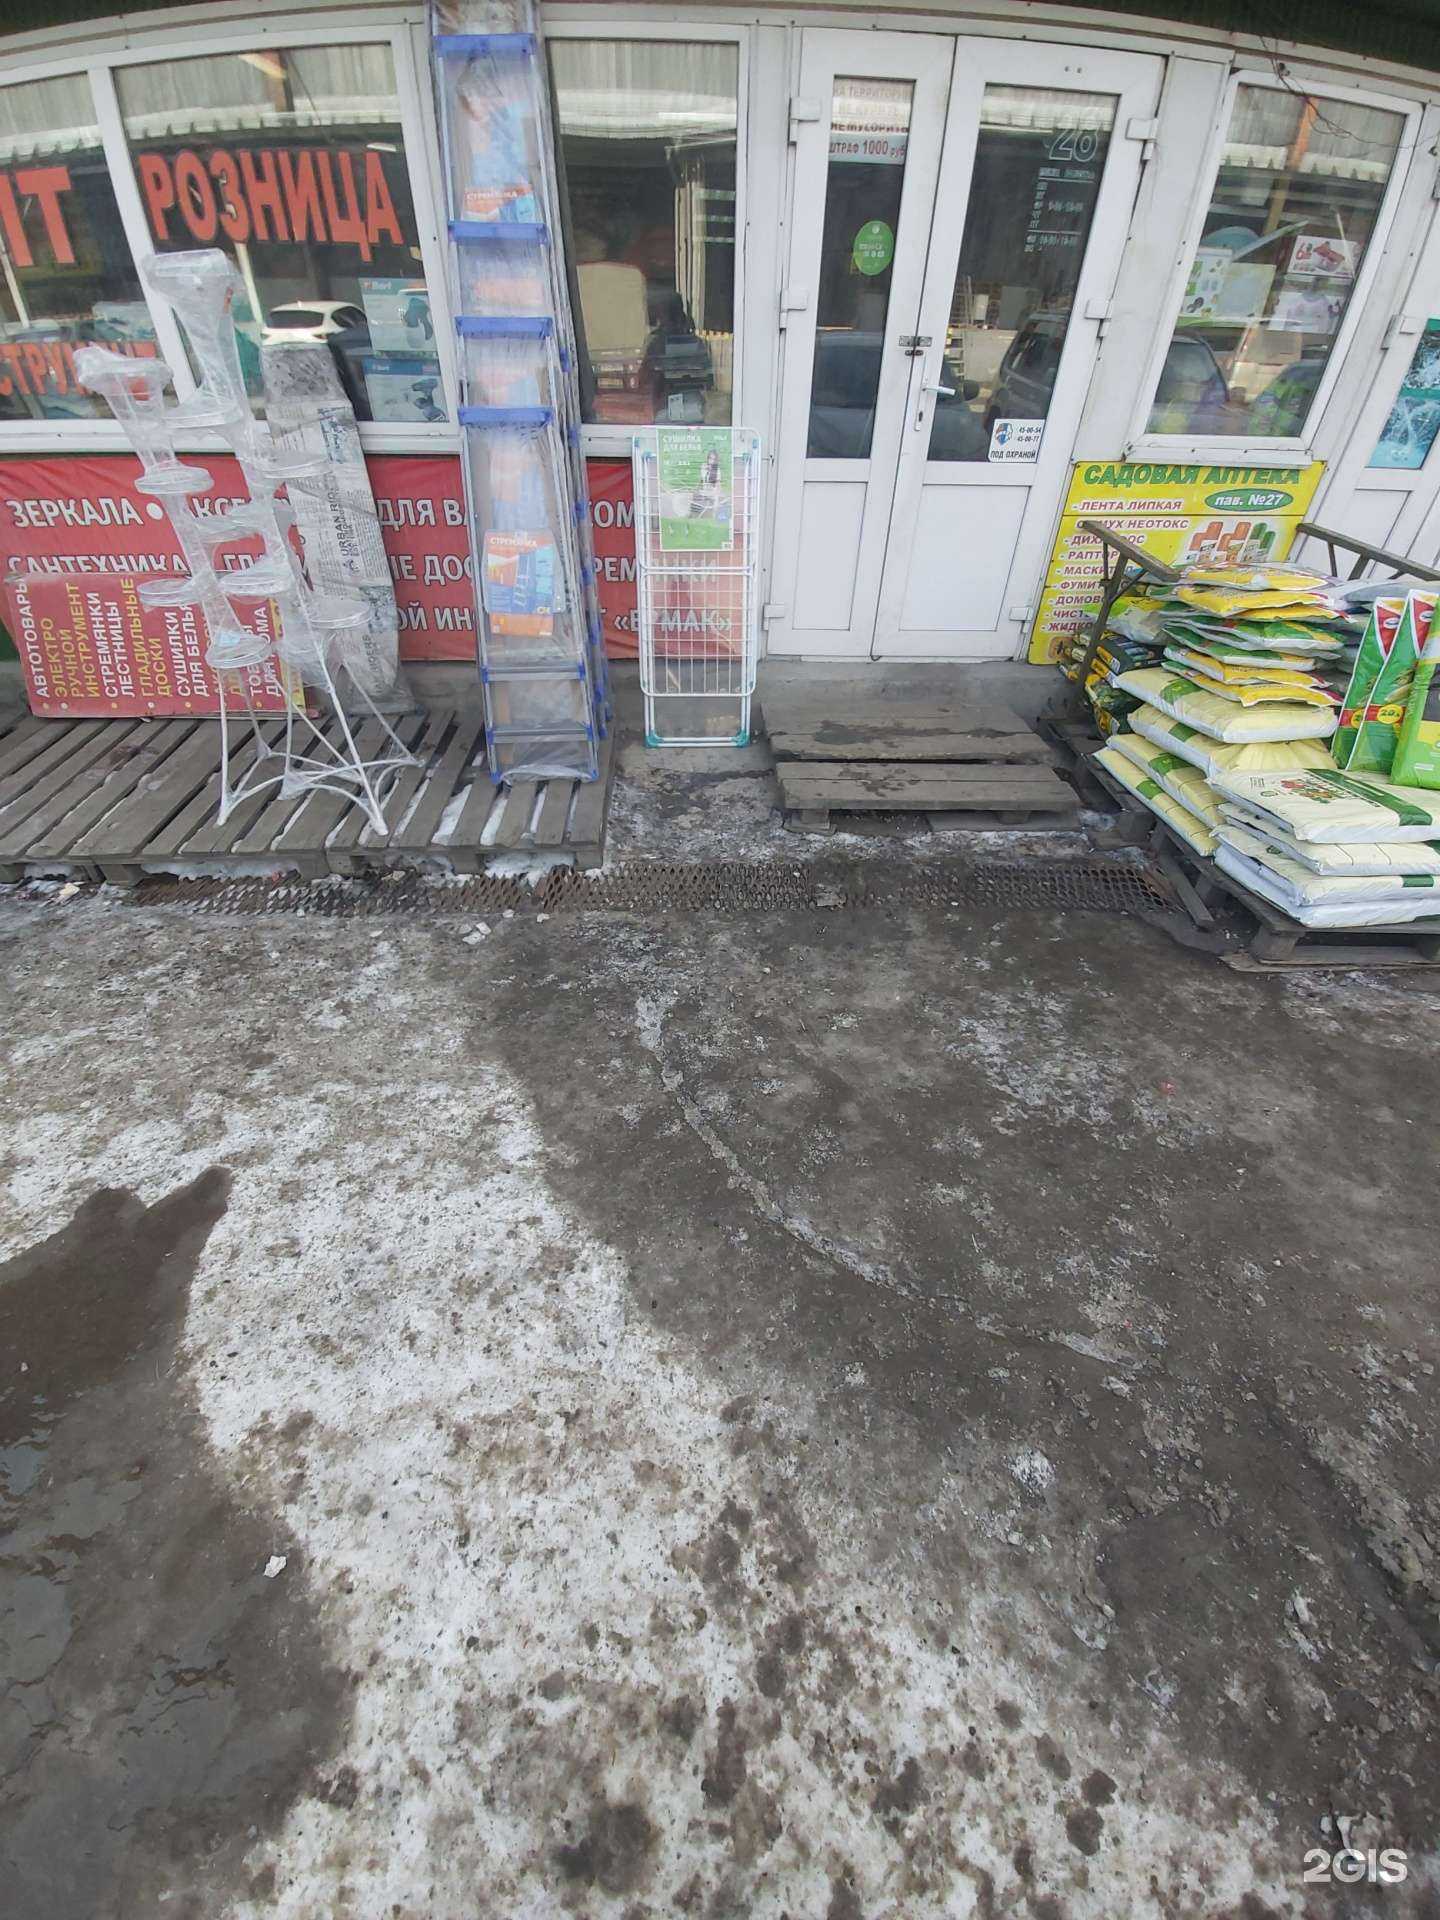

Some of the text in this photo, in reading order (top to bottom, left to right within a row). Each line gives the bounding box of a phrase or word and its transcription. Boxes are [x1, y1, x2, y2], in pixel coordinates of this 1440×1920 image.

[863, 140, 889, 155] 1000
[139, 147, 404, 263] РОЗНИЦА
[990, 449, 1036, 459] ПОД ОХРАНОЙ
[1084, 464, 1299, 488] САДОВАЯ АПТЕКА
[6, 498, 144, 528] ЗЕРКАЛА
[377, 498, 436, 532] ДЛЯ
[1080, 501, 1182, 511] ЛЕНТА ЛИПКАЯ
[1214, 493, 1284, 507] пав. №27
[1127, 519, 1189, 529] НЕОТОКС
[41, 617, 67, 697] ЭЛЕКТРО
[66, 582, 101, 698] ИНСТРУМЕНТ
[86, 592, 118, 698] СТРЕМЯНКИ
[104, 601, 136, 698] ЛЕСТНИЦЫ
[121, 578, 155, 697] ГЛАДИЛЬНЫЕ
[165, 611, 191, 697] СУШИЛКИ
[57, 629, 85, 698] РУЧНОЙ
[149, 638, 173, 697] ДОСКИ
[190, 661, 210, 697] ДЛЯ
